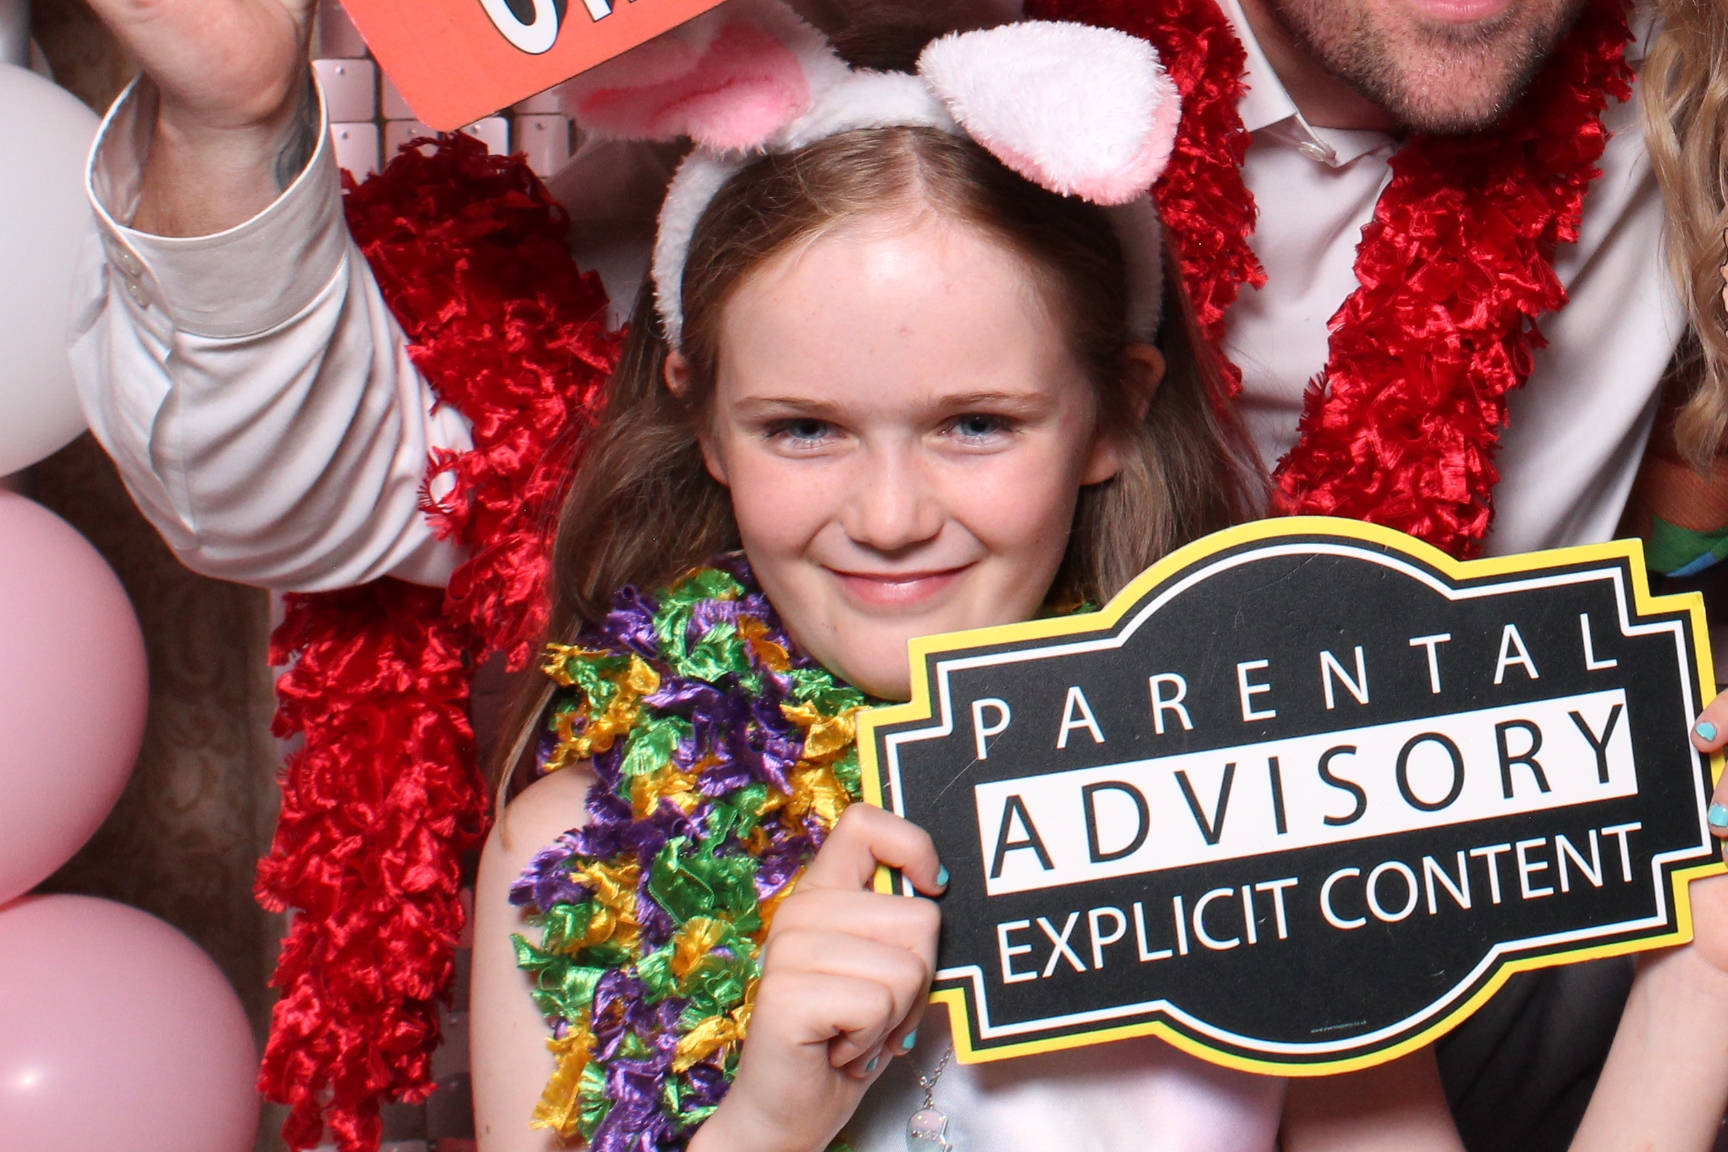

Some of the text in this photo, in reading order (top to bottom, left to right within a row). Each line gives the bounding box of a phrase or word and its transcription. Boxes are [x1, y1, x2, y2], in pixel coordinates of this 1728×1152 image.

[972, 612, 1620, 760] PARENTAL
[989, 703, 1625, 879] ADVISORY
[998, 822, 1643, 985] EXPLICIT CONTENT
